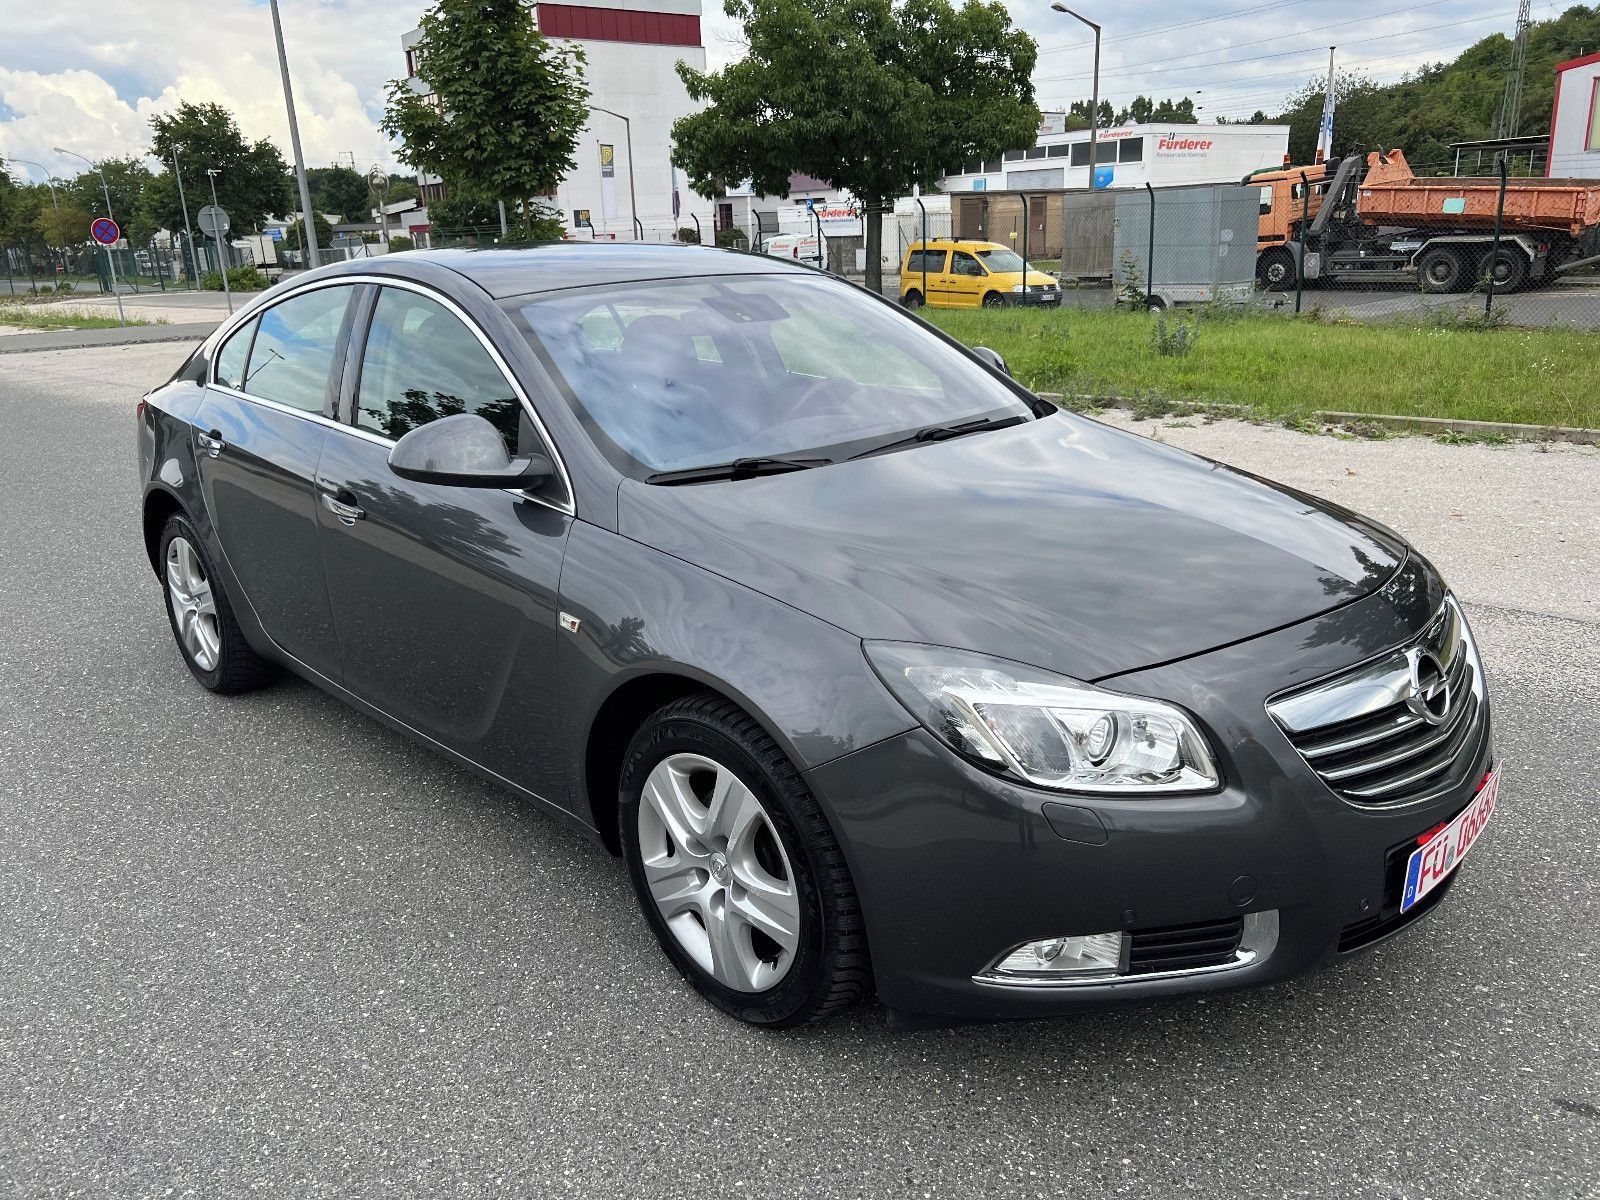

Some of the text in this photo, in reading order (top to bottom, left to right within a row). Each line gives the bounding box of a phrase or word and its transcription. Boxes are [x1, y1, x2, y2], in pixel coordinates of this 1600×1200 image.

[1158, 132, 1213, 150] Fürderer
[1418, 834, 1449, 893] FÜ
[1407, 885, 1413, 898] D
